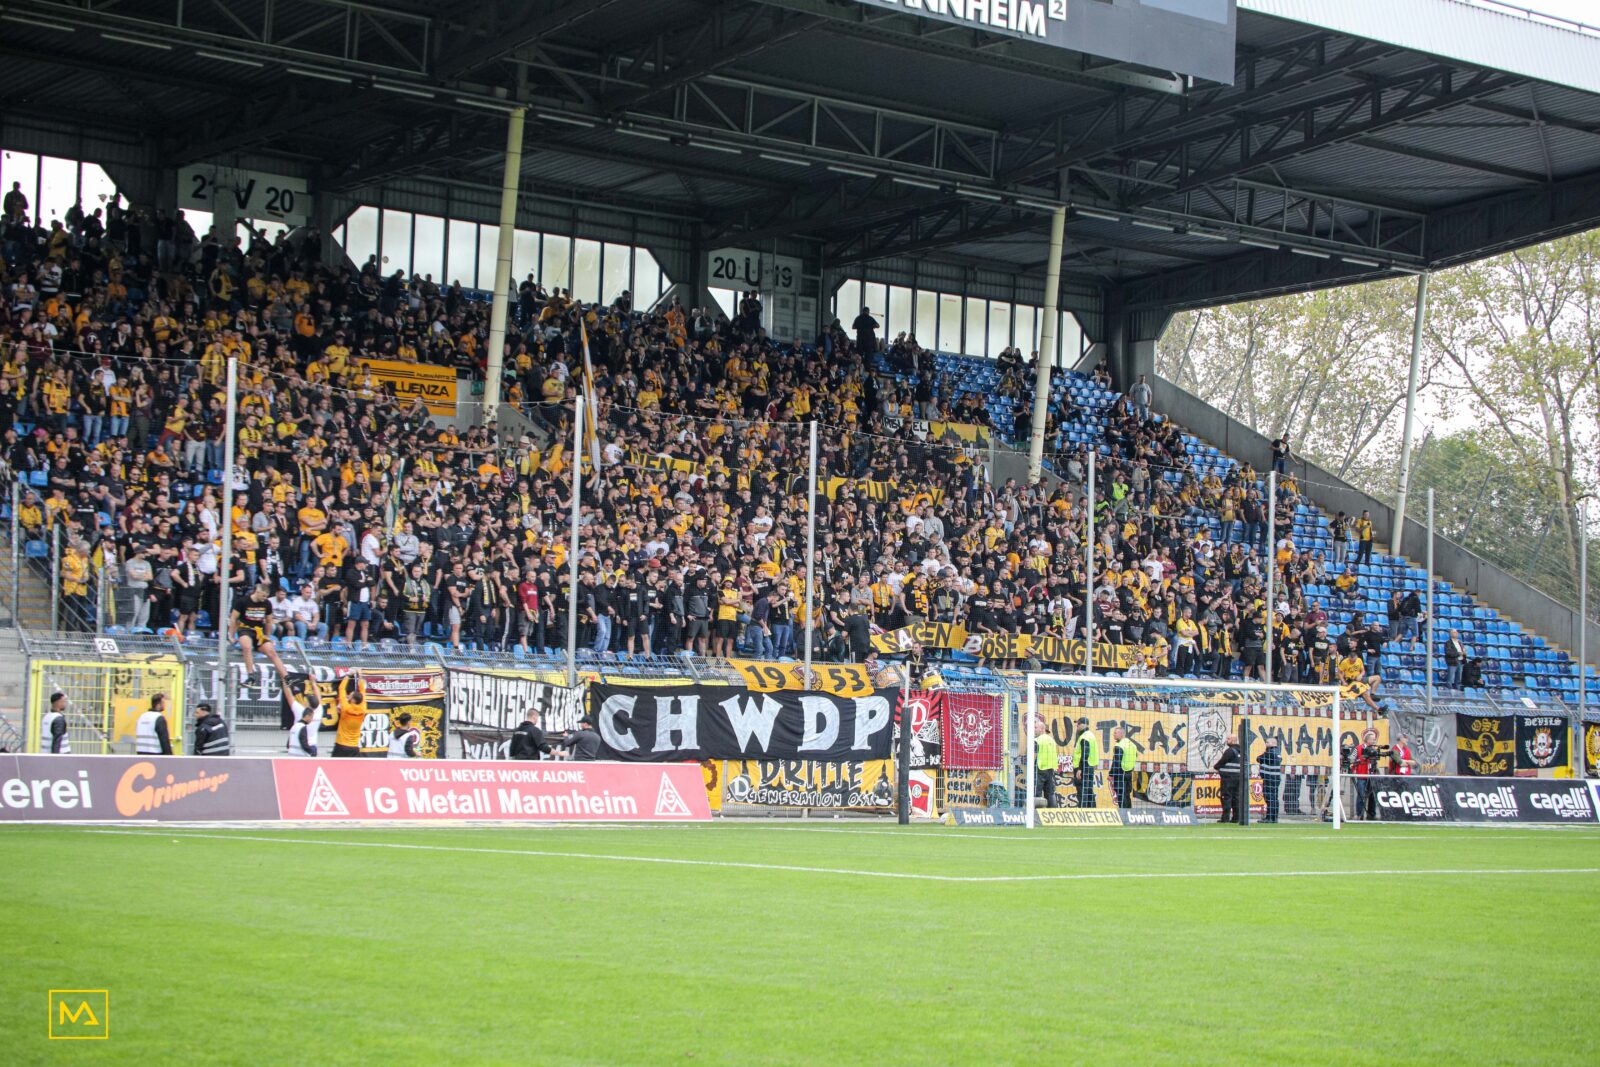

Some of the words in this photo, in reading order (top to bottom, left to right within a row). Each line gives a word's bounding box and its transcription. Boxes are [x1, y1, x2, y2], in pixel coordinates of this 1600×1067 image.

[192, 174, 214, 200] 2
[265, 187, 294, 213] 20
[713, 257, 737, 279] 20
[98, 641, 116, 651] 26
[1030, 635, 1118, 668] ZUNGEN!
[745, 665, 787, 688] 19
[828, 668, 866, 692] 53
[1051, 716, 1187, 755] UTRAS
[452, 768, 496, 783] NEVER
[498, 769, 539, 783] WORK
[542, 770, 585, 784] ALONE
[758, 758, 864, 791] DRITTE
[0, 770, 92, 809] erei
[115, 761, 230, 817] Grimminger
[364, 787, 399, 814] IG
[405, 788, 491, 814] Metall
[497, 788, 638, 815] Mannheim
[750, 789, 842, 806] GENERATION
[1377, 785, 1442, 814] capelli
[1455, 786, 1518, 815] capelli
[1530, 787, 1591, 815] capelli
[963, 811, 994, 824] bwin
[1002, 811, 1027, 824] bwi
[1041, 811, 1121, 824] SPORTWETTEN
[1127, 811, 1155, 823] bwin
[1162, 811, 1191, 824] bwin
[1411, 808, 1444, 817] SPORT
[1487, 808, 1519, 818] SPORT
[1560, 809, 1592, 818] SPORT
